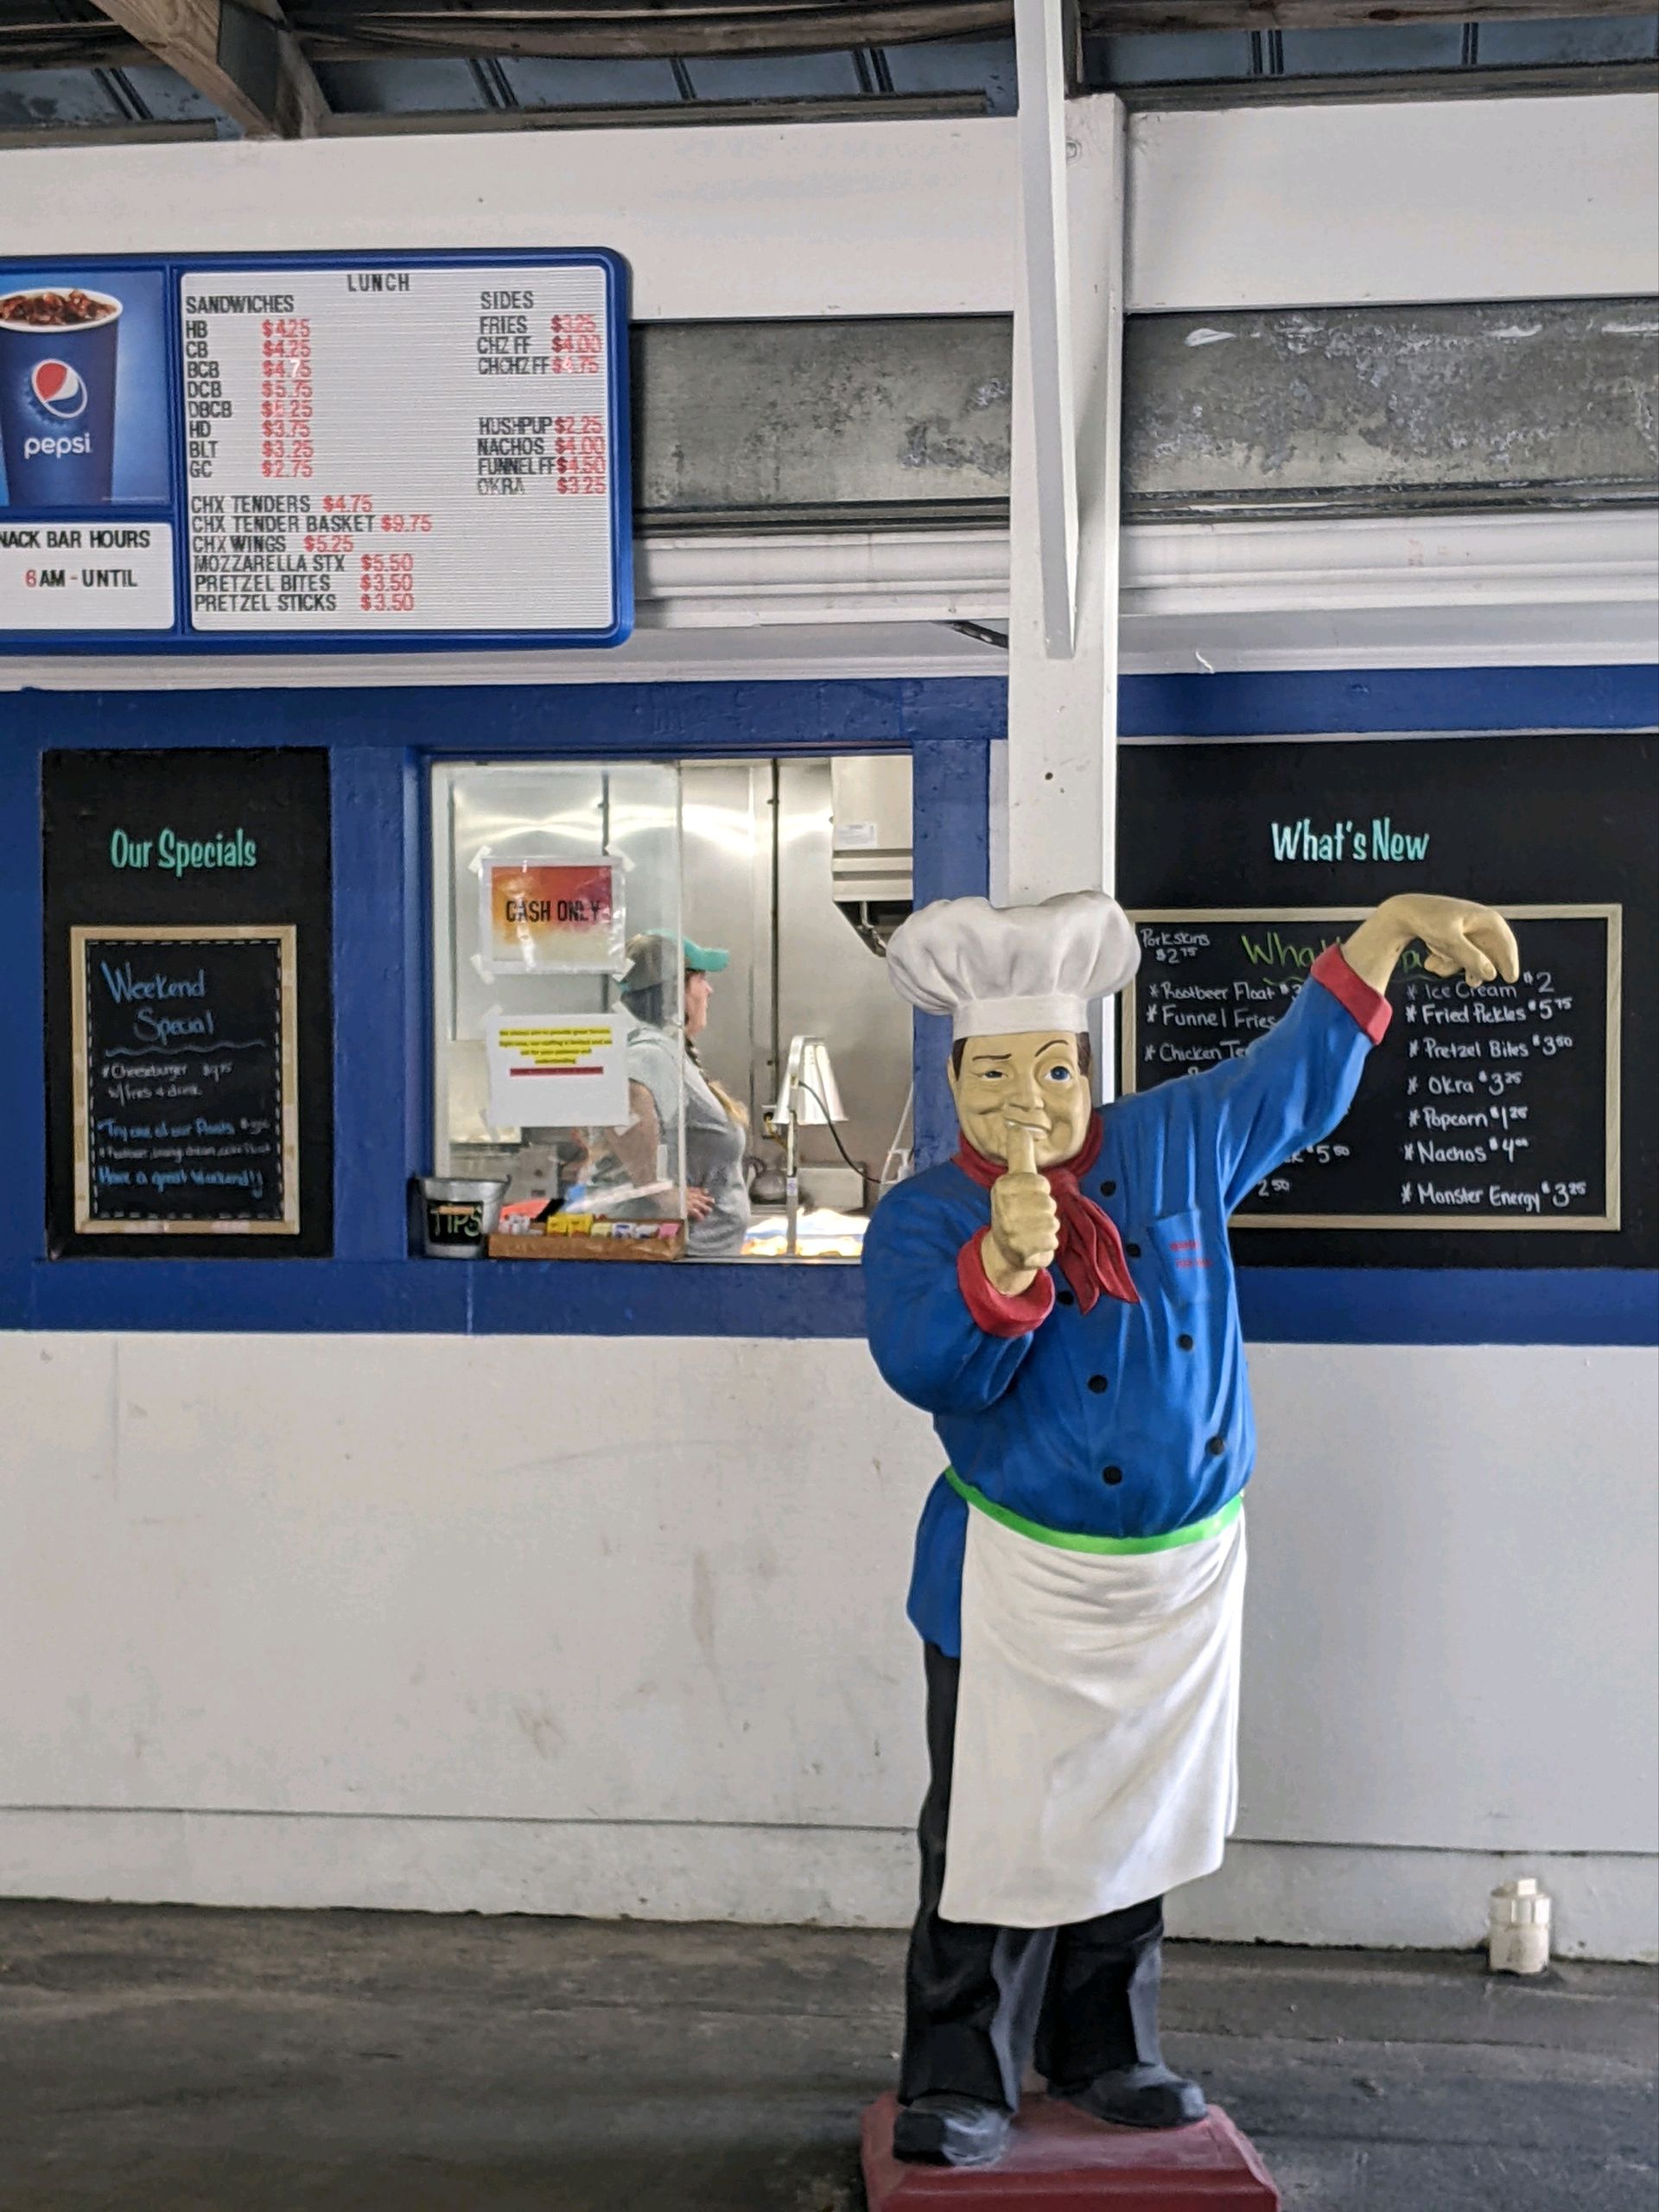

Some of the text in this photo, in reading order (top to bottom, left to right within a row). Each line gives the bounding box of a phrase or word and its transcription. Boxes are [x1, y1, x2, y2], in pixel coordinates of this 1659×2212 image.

[347, 273, 410, 292] LUNCH
[186, 295, 295, 314] SANDWICHES
[480, 290, 534, 309] SIDES
[185, 321, 207, 339] HB
[480, 315, 528, 334] FRIES
[186, 340, 207, 359] CB
[188, 360, 219, 378] BCB
[188, 380, 222, 398] DCB
[188, 400, 232, 418] DBCB
[189, 420, 212, 438] HD
[24, 433, 91, 459] pepsi
[189, 441, 219, 458] BLT
[477, 436, 544, 455] NACHOS
[189, 460, 213, 479] GC
[191, 494, 373, 514] CHX TENDERS $4.75
[192, 515, 226, 534] CHX
[234, 515, 300, 533] TENDER
[306, 514, 375, 533] BASKET
[47, 531, 81, 549] BAR
[90, 530, 150, 548] HOURS
[193, 535, 354, 554] CHX WINGS $5.25
[194, 555, 308, 574] MOZZARELLA
[312, 554, 346, 573] STX
[25, 569, 66, 588] 6AM
[81, 569, 138, 587] UNTIL
[194, 575, 276, 593] PRETZEL
[281, 574, 331, 593] BITES
[194, 594, 271, 613] PRETZEL
[277, 594, 337, 612] STICKS
[1271, 817, 1431, 862] What's New
[111, 827, 257, 878] Our Specials
[505, 899, 601, 923] CASH ONLY
[100, 959, 206, 1004] Weekend
[1161, 982, 1230, 1001] Rootbeer
[1233, 981, 1275, 1001] Float
[1426, 983, 1452, 1000] Ice
[1162, 1004, 1227, 1028] Funnel
[1421, 1002, 1470, 1025] Fried
[1472, 1001, 1527, 1024] Pickles
[1159, 1043, 1222, 1063] Chicken
[1422, 1037, 1481, 1058] Pretzel
[1489, 1039, 1529, 1058] Bites
[1428, 1075, 1475, 1096] Okra
[1422, 1105, 1489, 1131] Popcorn
[1417, 1139, 1488, 1165] Nachos
[1417, 1181, 1484, 1205] Monster
[1489, 1184, 1541, 1213] Energy
[430, 1206, 483, 1237] TIPS
